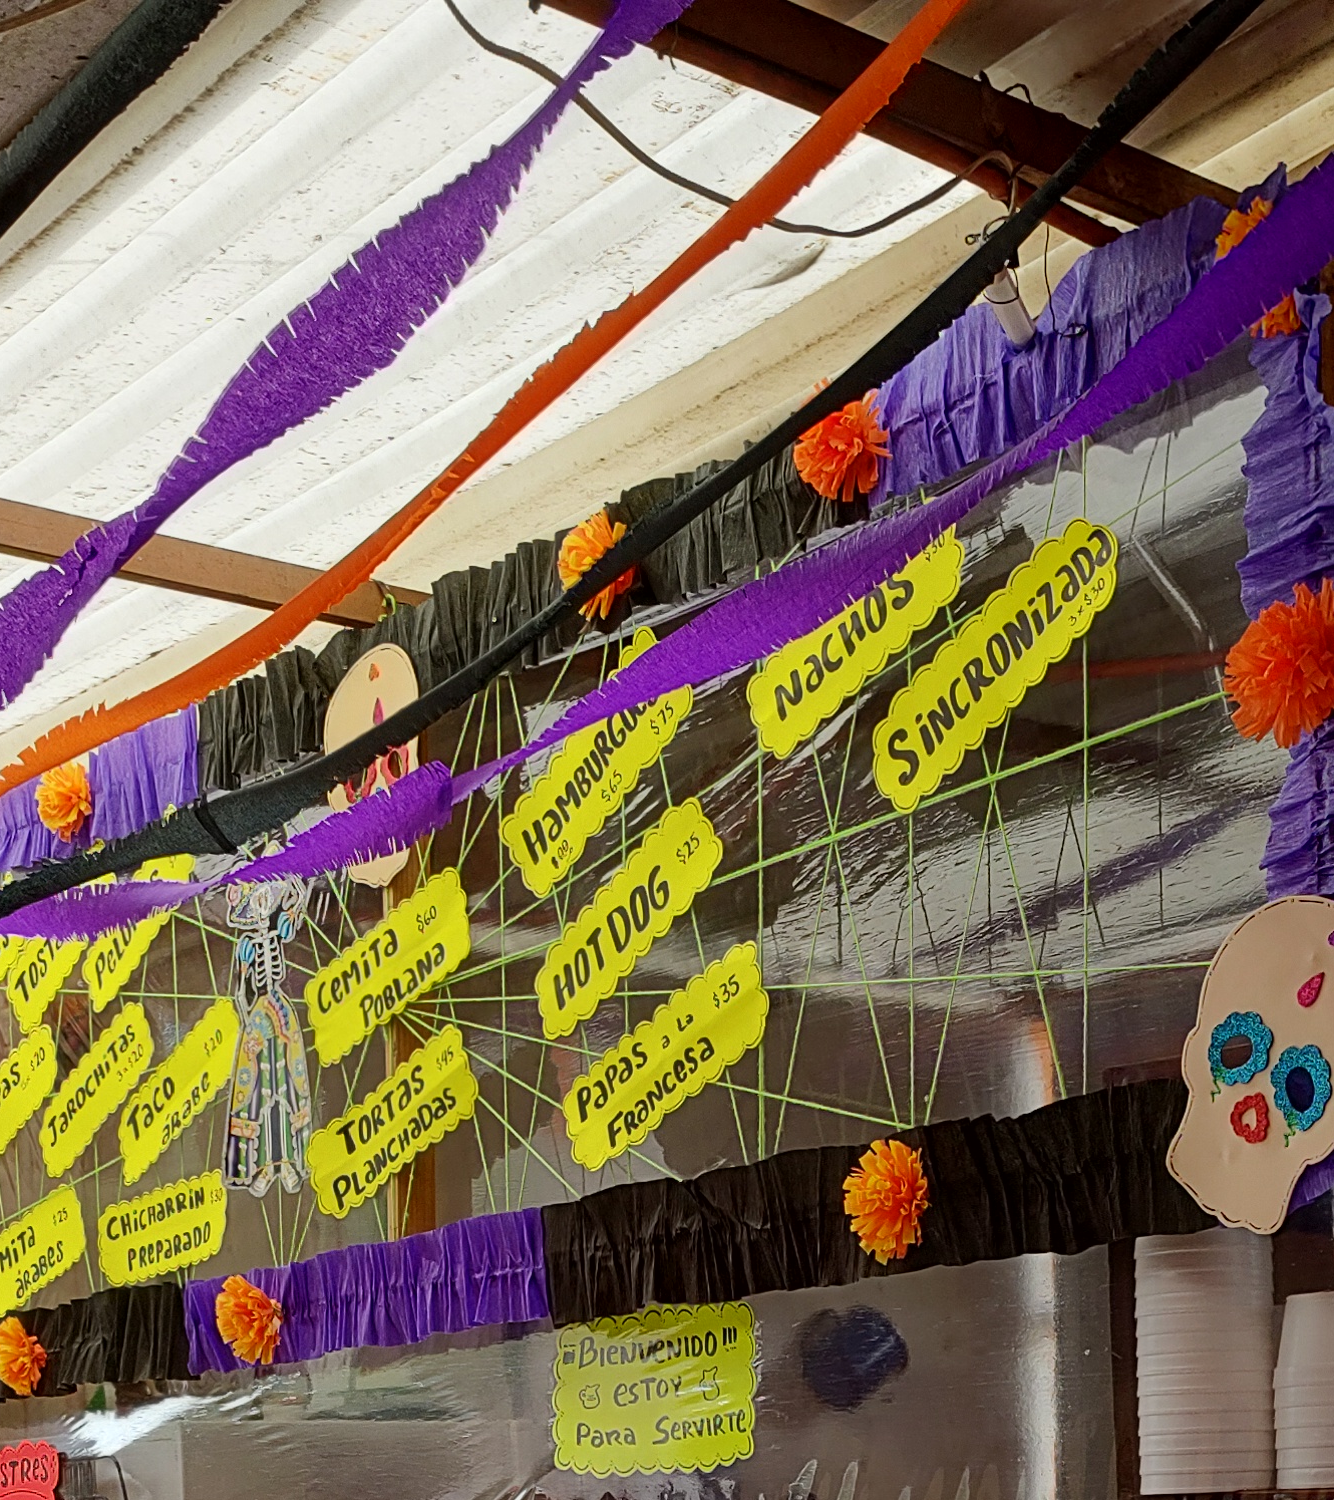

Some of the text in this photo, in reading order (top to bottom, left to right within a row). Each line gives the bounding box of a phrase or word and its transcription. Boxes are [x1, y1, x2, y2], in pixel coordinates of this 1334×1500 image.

[774, 576, 914, 722] NaCHOS
[317, 905, 437, 1014] CeMiTa $60
[553, 927, 605, 1011] HOT
[607, 865, 670, 954] DOG
[676, 831, 700, 864] $25
[360, 942, 445, 1028] POBLaNa
[47, 1024, 136, 1147] JaROCHiTaS
[576, 1042, 648, 1123] PaPaS
[712, 973, 740, 1010] $35
[607, 1036, 715, 1149] FRaNCeSa
[126, 1076, 175, 1141] TaCO
[332, 1087, 456, 1211] PLaNCHaDaS
[336, 1064, 425, 1156] TORTaS
[576, 1423, 636, 1448] PaRa
[614, 1376, 682, 1407] eSTOY
